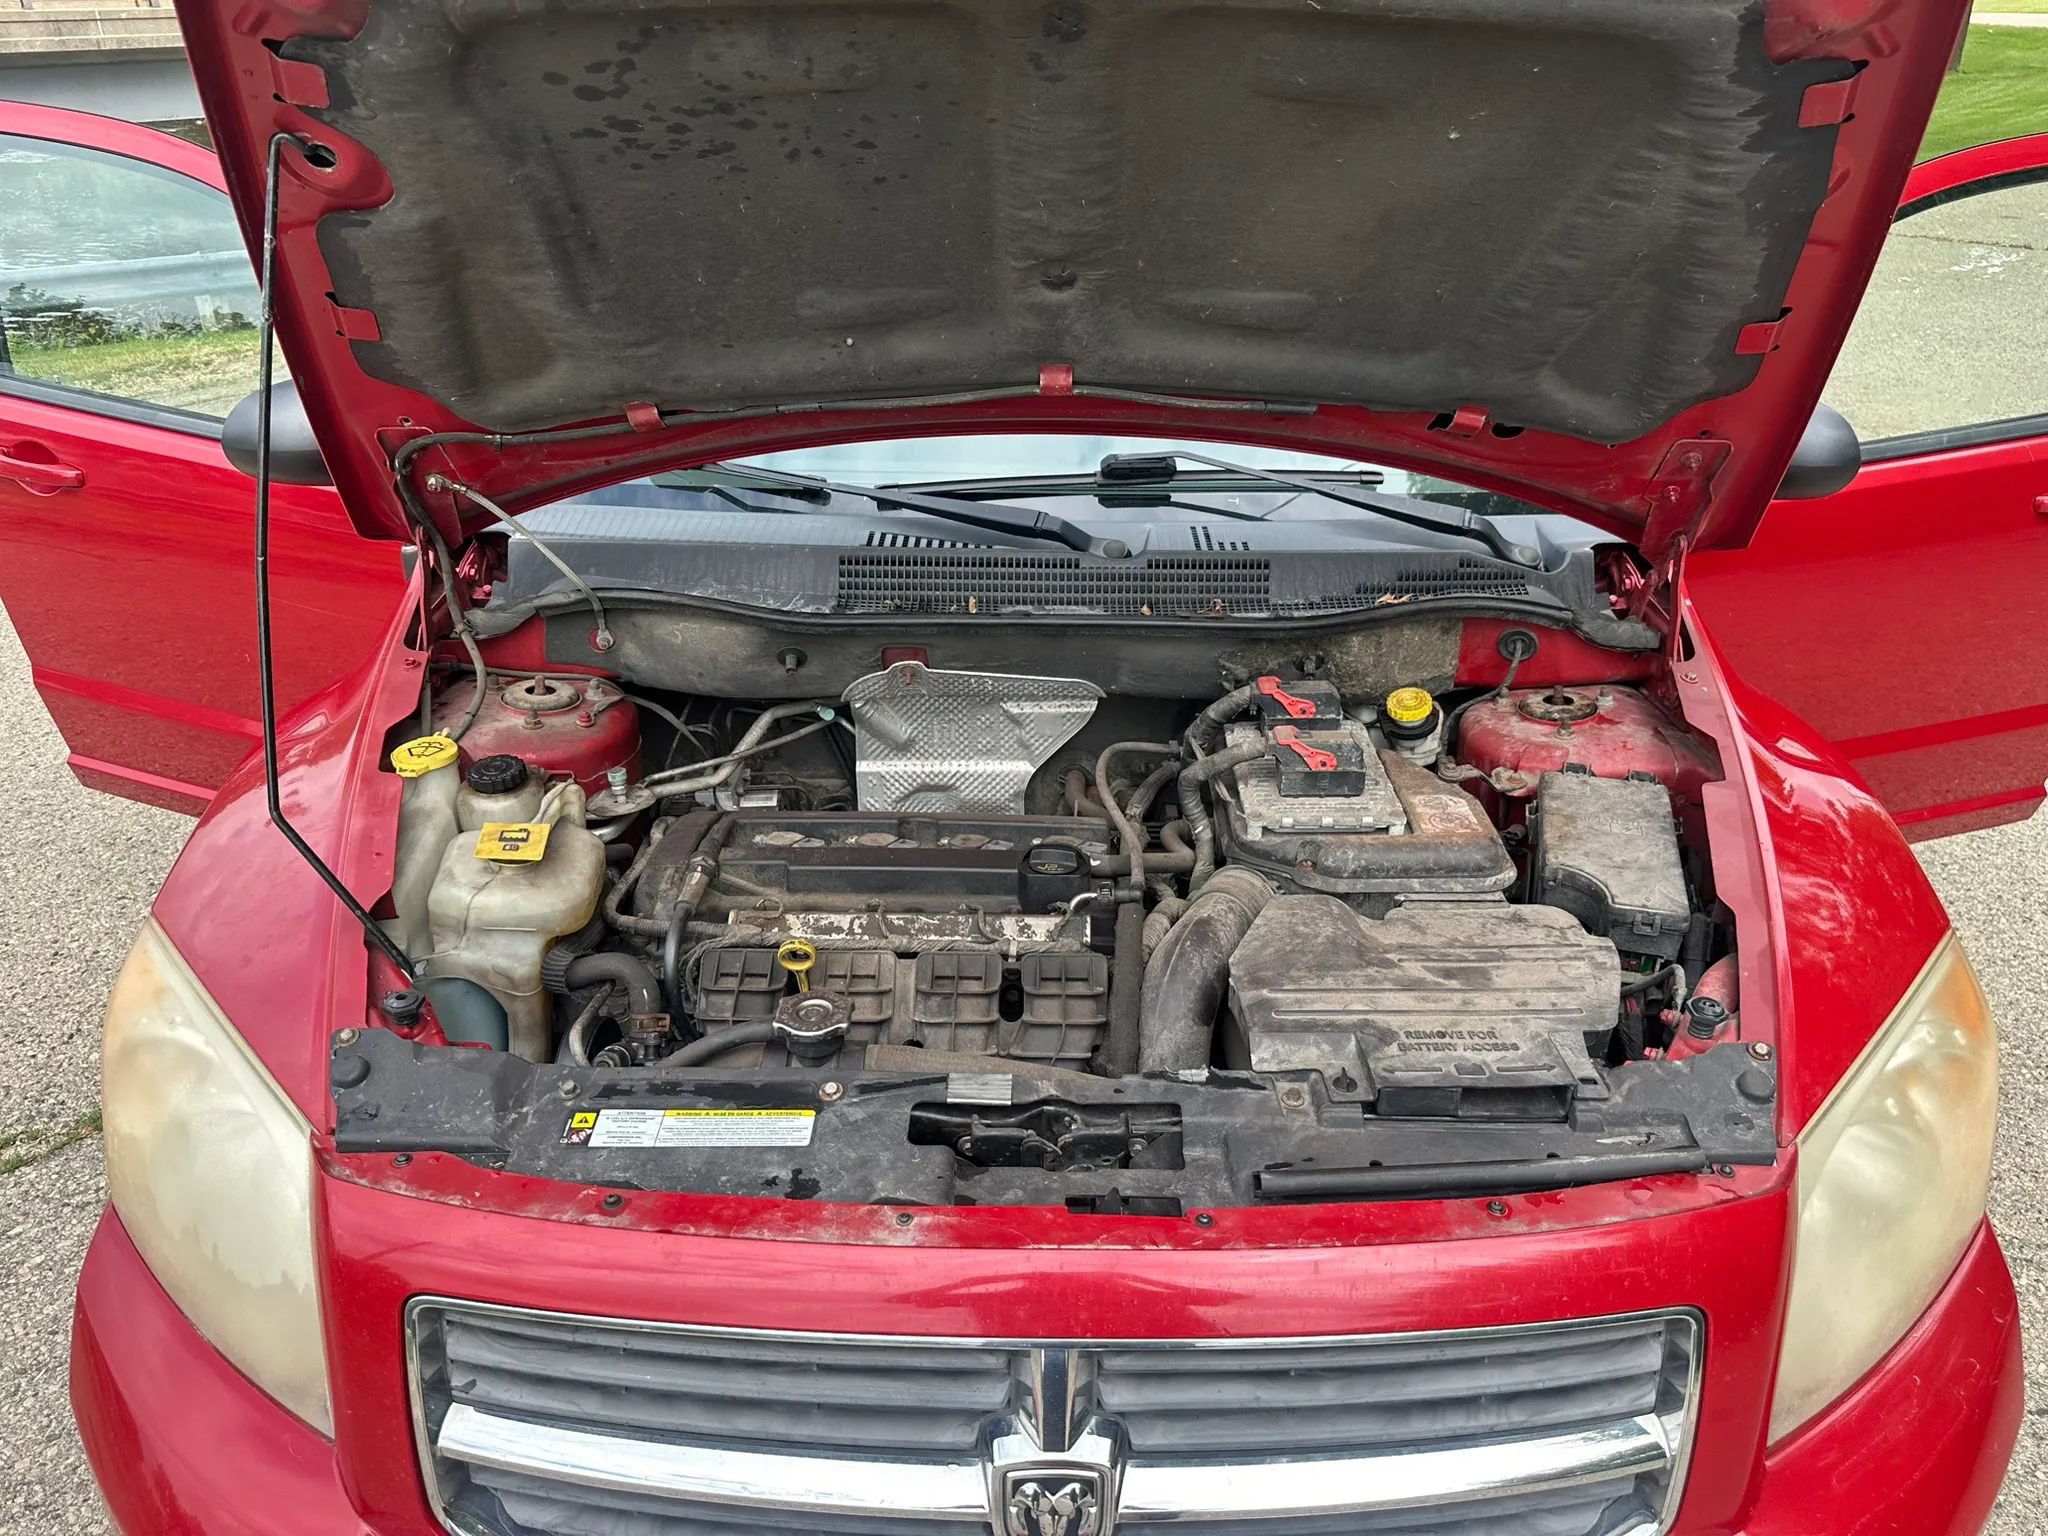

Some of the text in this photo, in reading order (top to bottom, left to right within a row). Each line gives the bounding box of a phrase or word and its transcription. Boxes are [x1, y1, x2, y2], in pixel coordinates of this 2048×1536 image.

[1404, 1030, 1498, 1040] REMOVE FOR
[1397, 1042, 1520, 1052] BATTERY ACCESS
